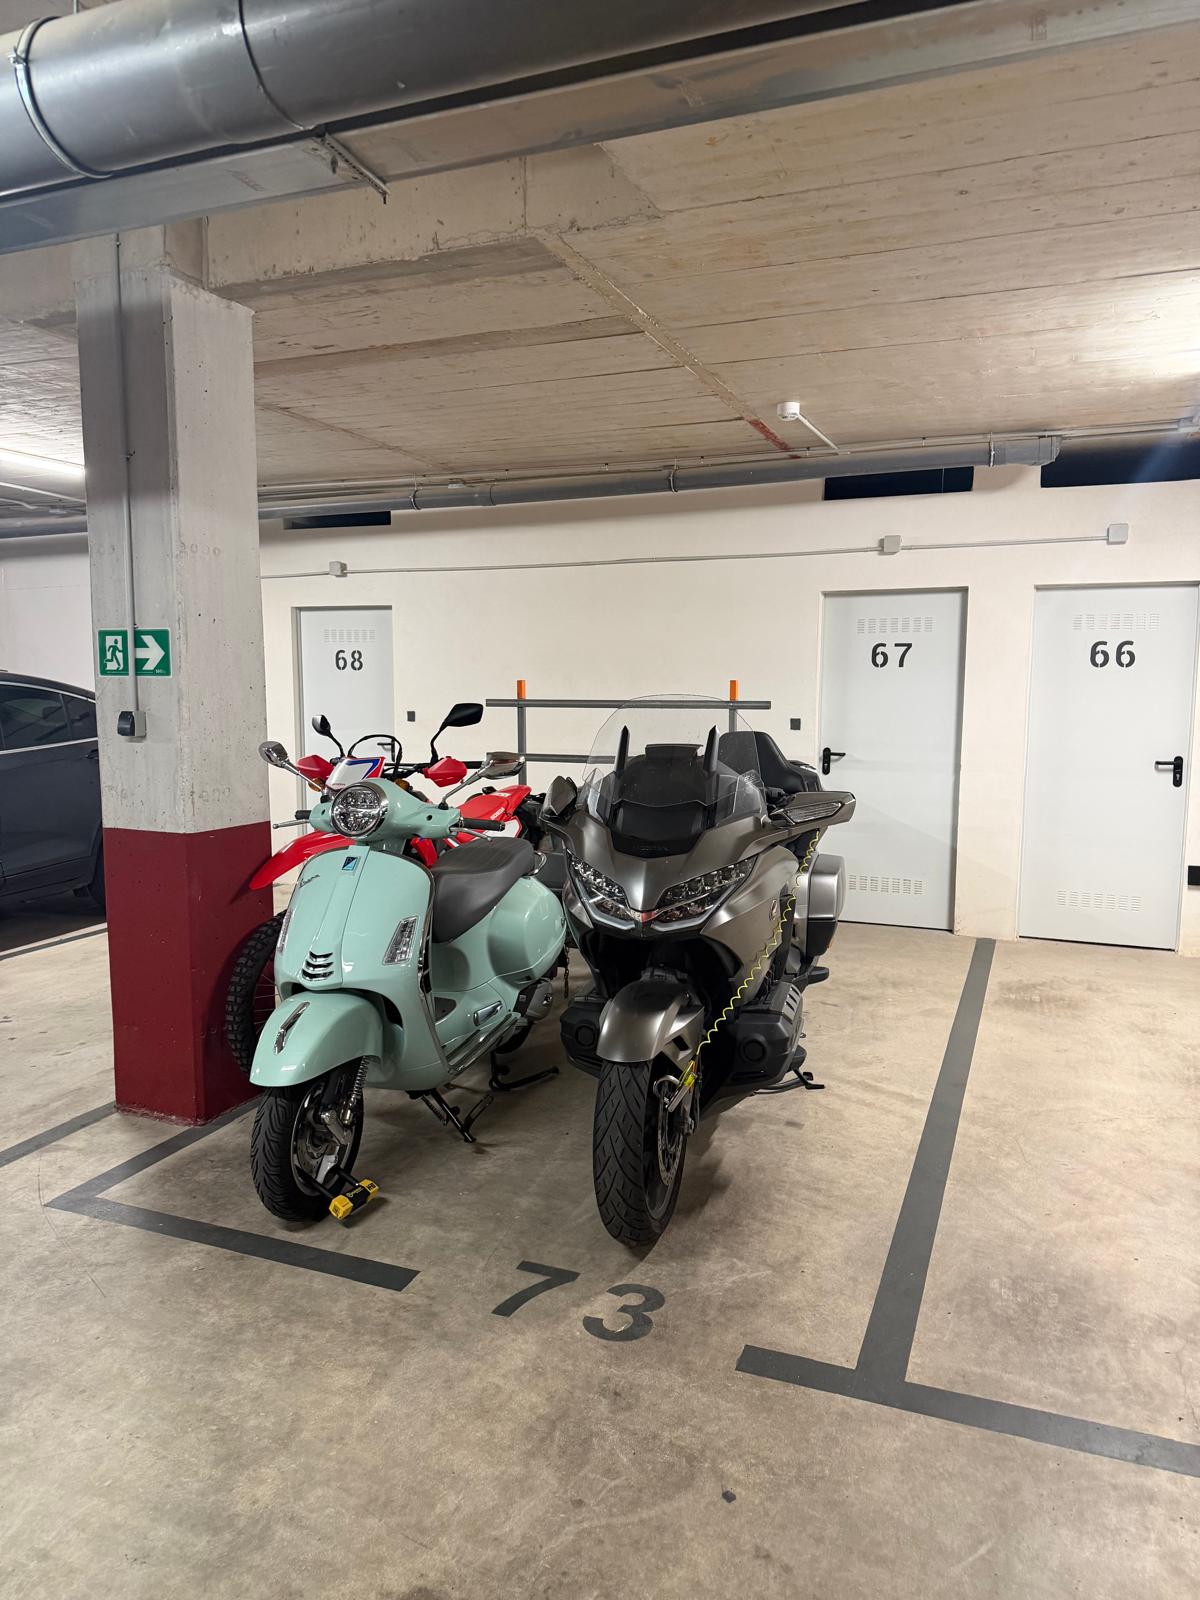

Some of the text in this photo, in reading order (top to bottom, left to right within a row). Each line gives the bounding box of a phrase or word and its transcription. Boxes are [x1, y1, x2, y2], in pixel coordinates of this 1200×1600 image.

[336, 650, 363, 670] 68
[872, 643, 912, 668] 67
[1090, 641, 1135, 668] 66
[492, 1260, 665, 1341] 73
